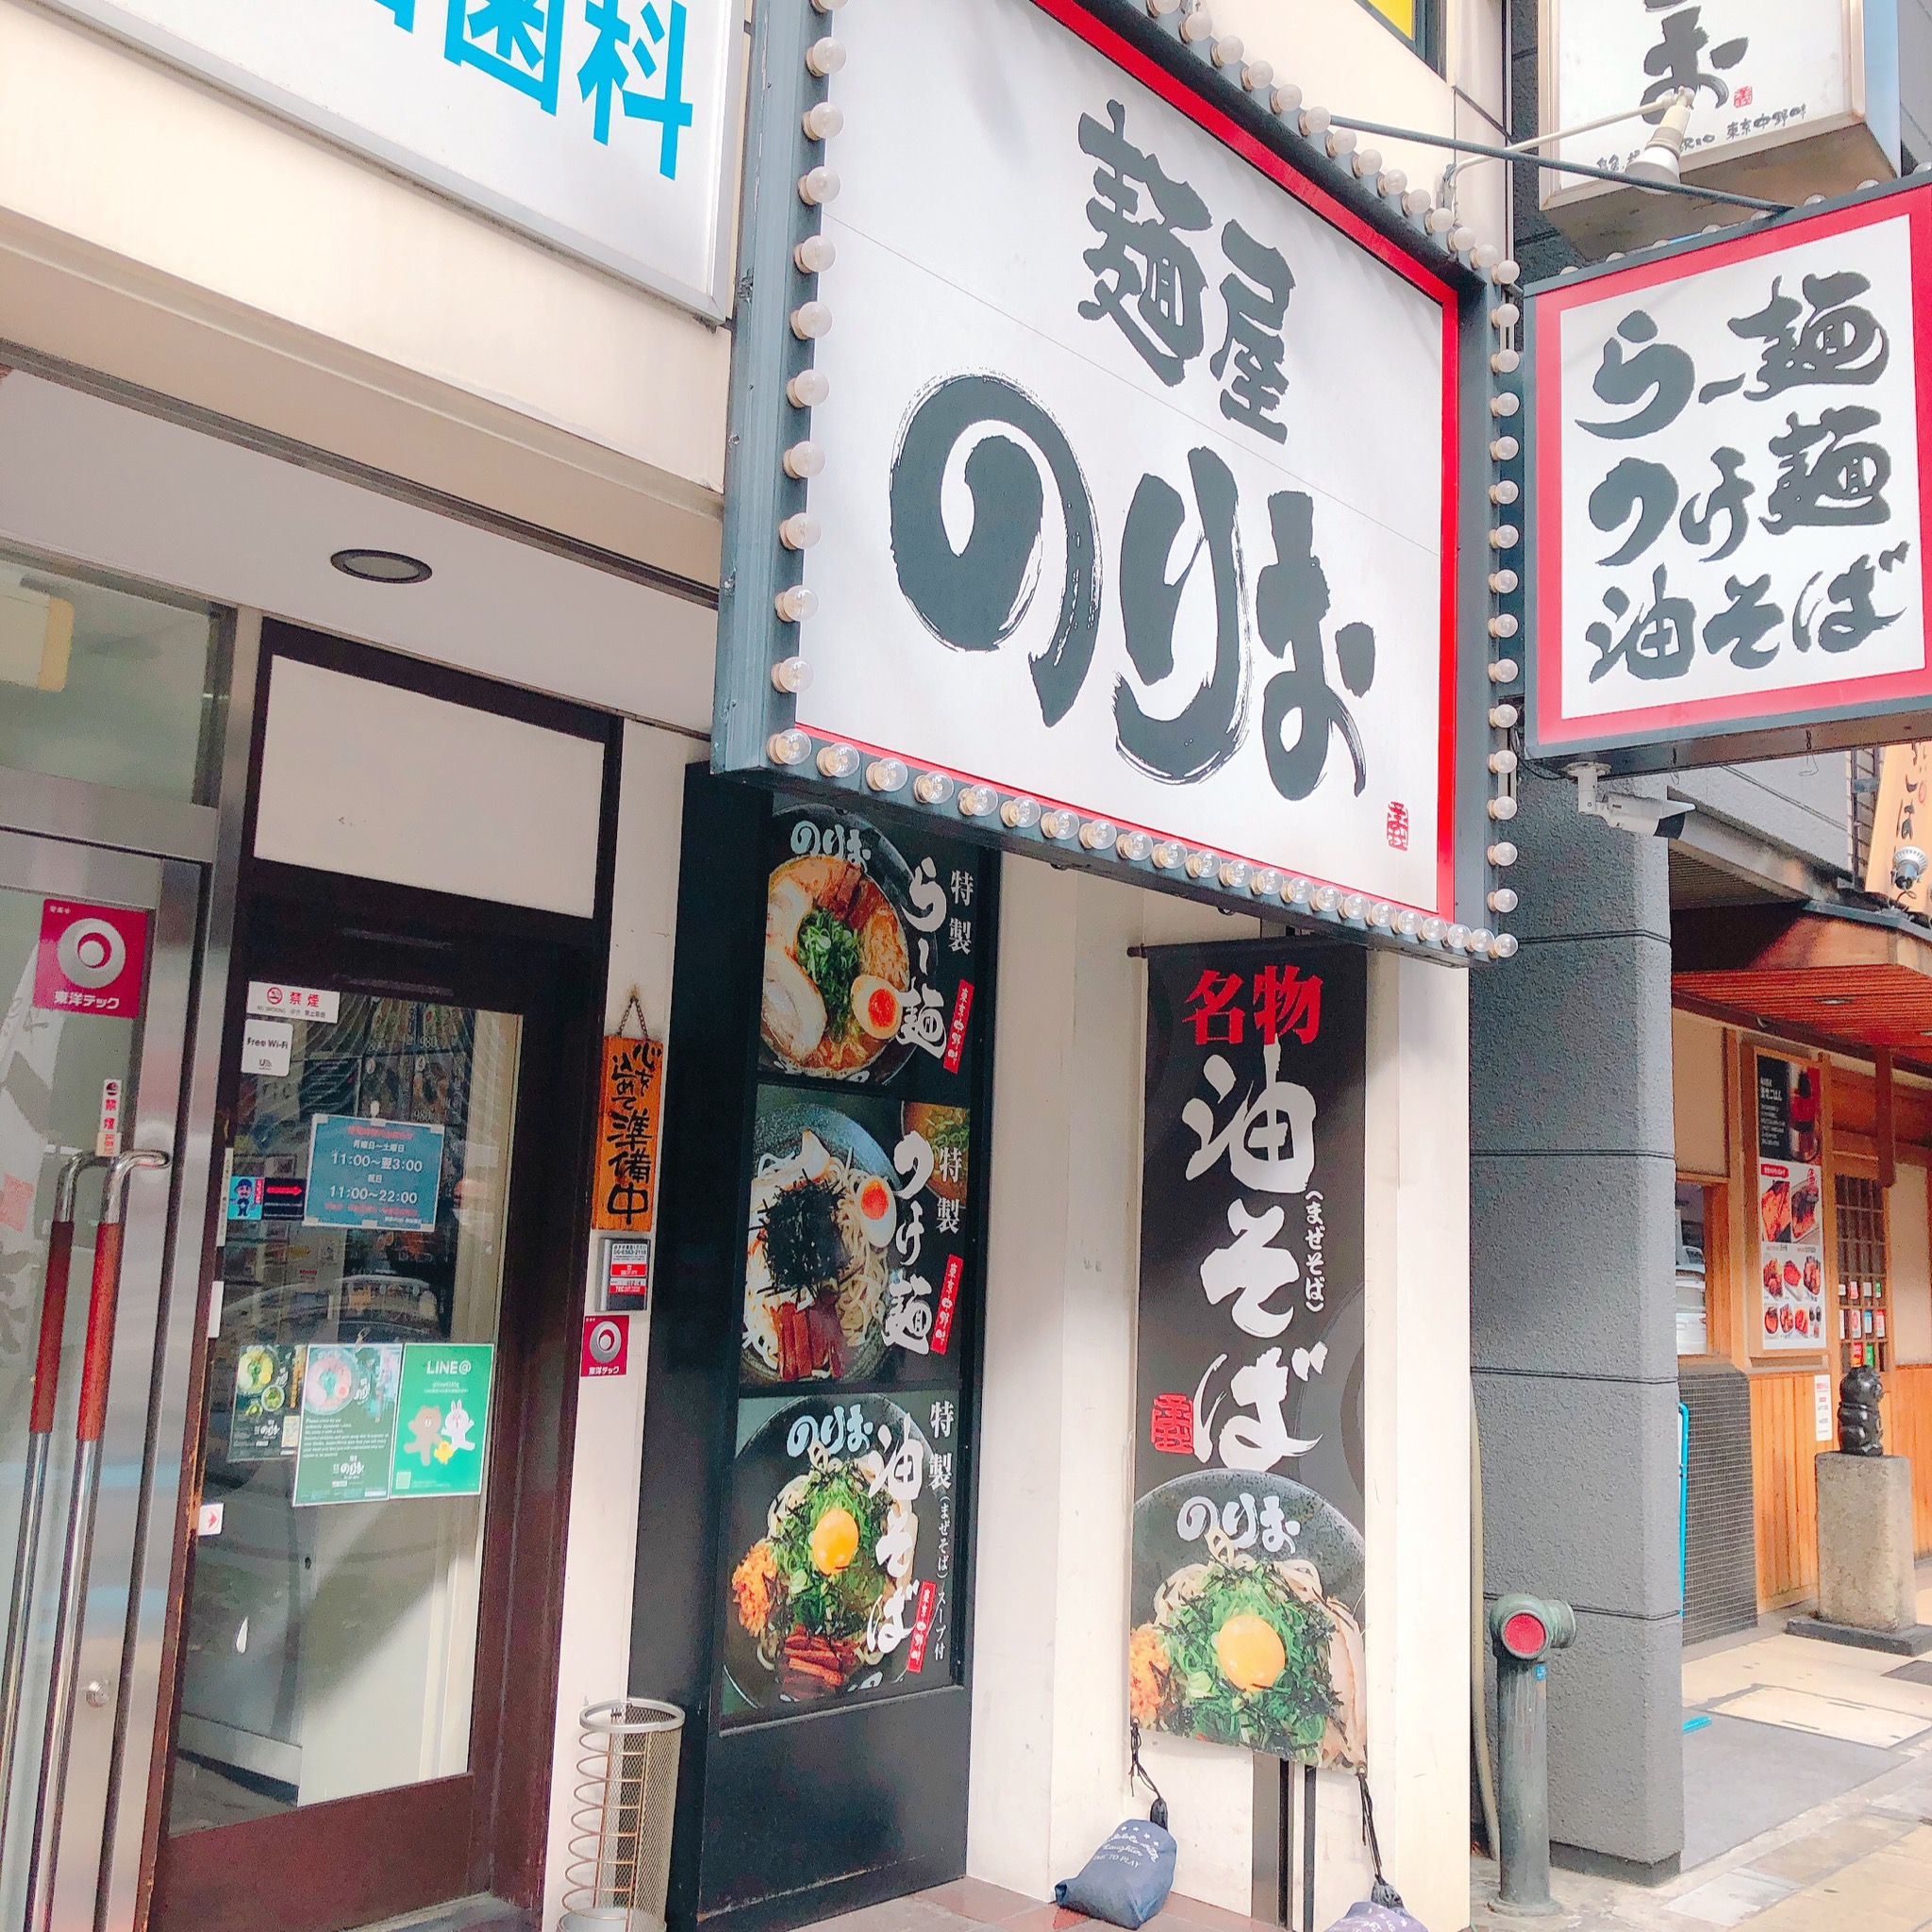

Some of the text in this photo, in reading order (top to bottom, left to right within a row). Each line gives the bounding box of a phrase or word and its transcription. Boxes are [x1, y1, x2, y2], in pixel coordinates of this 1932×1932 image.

[375, 0, 692, 180] 歯科
[1077, 99, 1298, 444] 麺屋
[1574, 270, 1890, 441] らー麺
[1588, 405, 1892, 566] つけ麺
[890, 366, 1376, 803] のりお
[1585, 541, 1909, 683] 油そば
[791, 820, 871, 874] のりお
[948, 869, 974, 956] 特製
[54, 991, 120, 1009] 東洋テック
[247, 1037, 289, 1049] Free Wi-Fi
[290, 991, 319, 1008] 禁煙
[1182, 964, 1324, 1045] 名物
[607, 1109, 653, 1224] 準備中
[935, 1146, 962, 1234] 特製
[1182, 1034, 1328, 1471] 油そば
[425, 1359, 472, 1375] LINE@
[787, 1403, 874, 1457] のりお
[927, 1401, 954, 1491] 特製
[866, 1412, 924, 1654] 油そば
[1176, 1493, 1301, 1554] のりお
